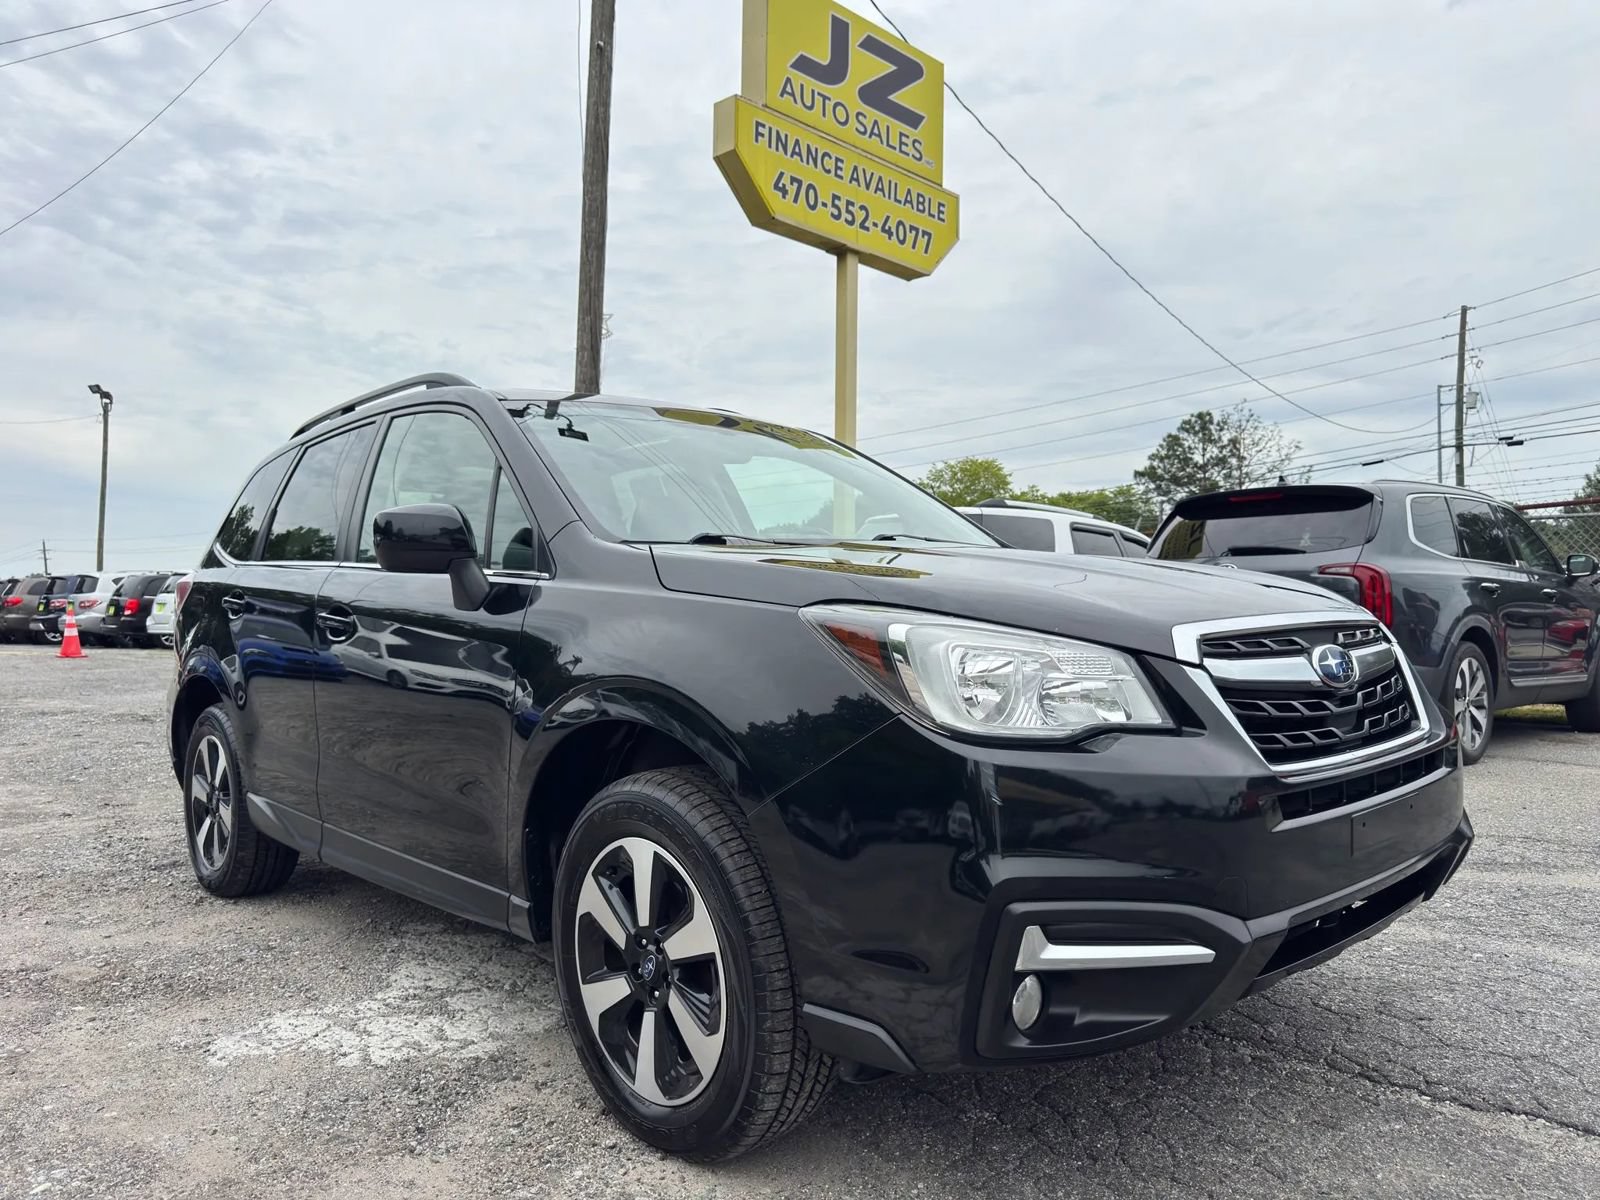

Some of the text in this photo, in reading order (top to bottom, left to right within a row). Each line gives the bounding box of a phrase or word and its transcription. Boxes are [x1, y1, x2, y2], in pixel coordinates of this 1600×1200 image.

[789, 13, 926, 130] JZ
[779, 76, 850, 127] AUTO
[854, 111, 924, 162] SALES
[754, 120, 946, 223] FINANCE AVAILABLE
[773, 171, 933, 254] 470-552-4077
